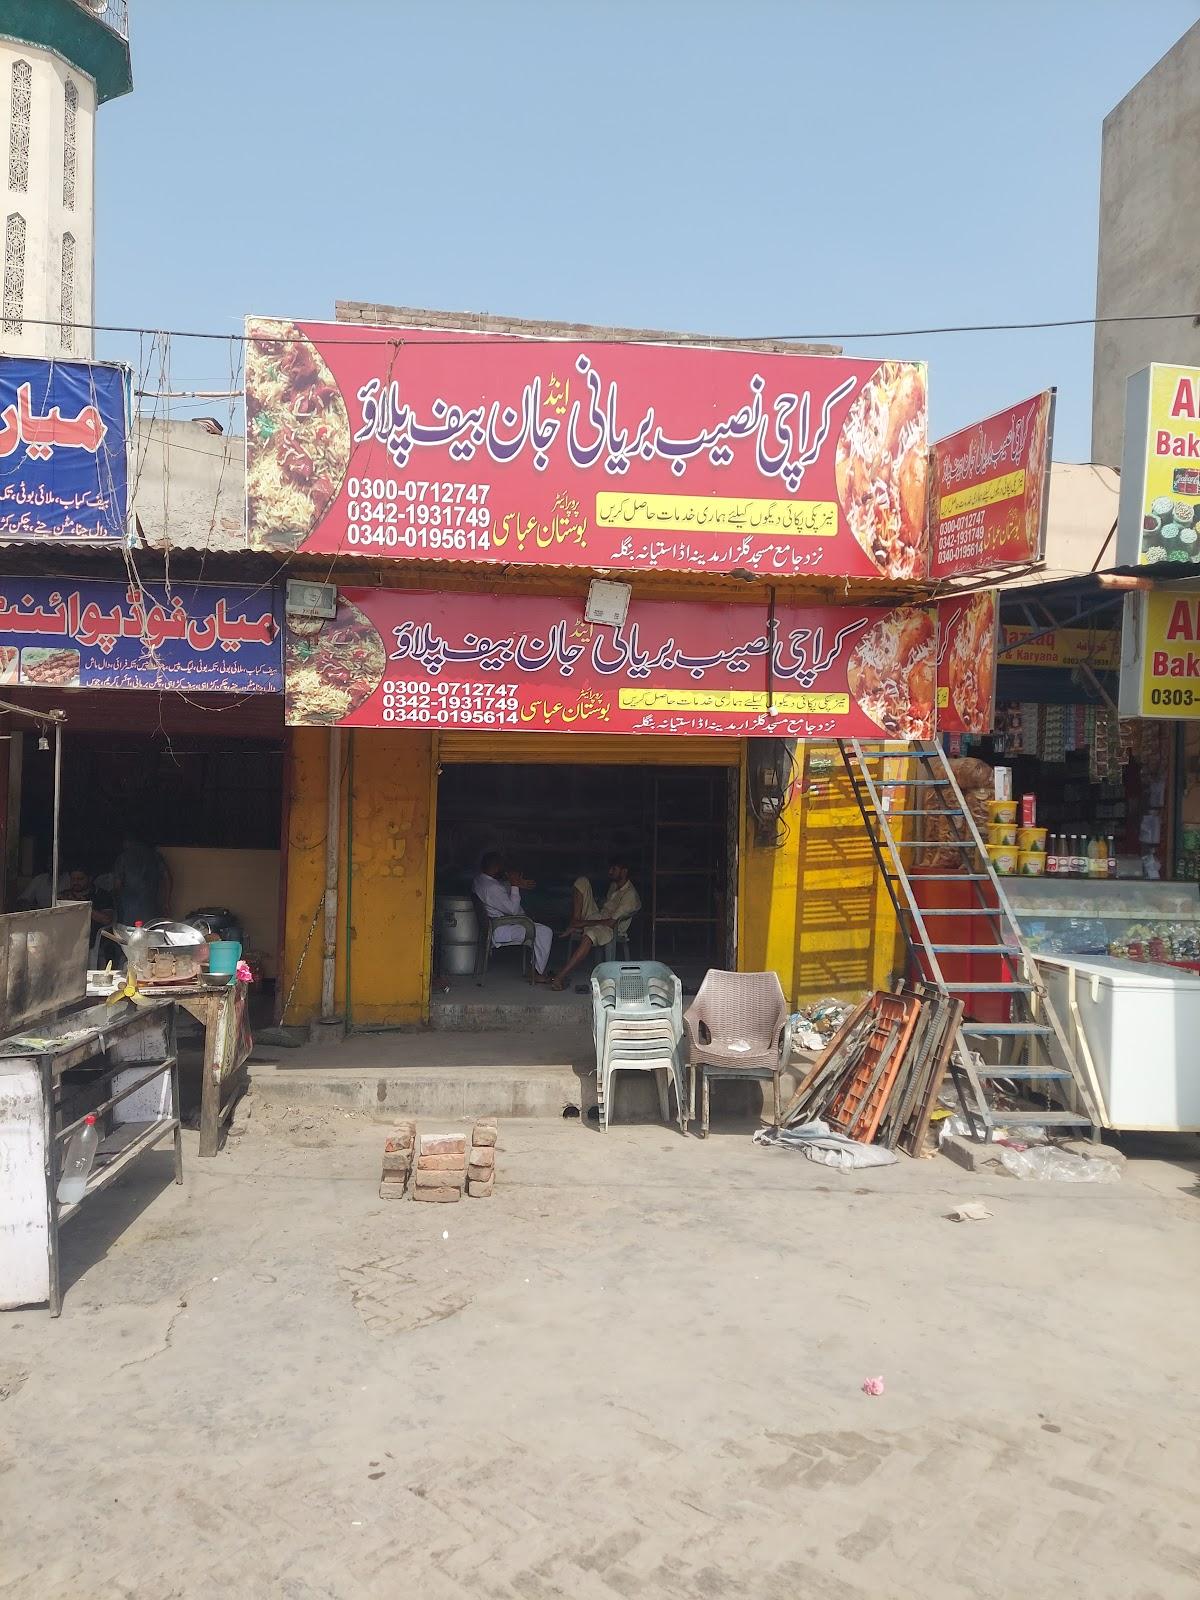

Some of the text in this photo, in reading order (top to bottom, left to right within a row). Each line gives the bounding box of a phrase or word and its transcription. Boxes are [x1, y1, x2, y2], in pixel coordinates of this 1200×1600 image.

[1172, 379, 1200, 418] A
[354, 353, 858, 493] کراچی نصیب بریانی اینڈ جان بیف پلاؤ
[34, 484, 55, 505] ملائی
[86, 493, 110, 509] بیف
[348, 478, 490, 504] 0300-0712747
[347, 501, 490, 527] 0342-1931749
[599, 498, 628, 522] کریں
[624, 500, 655, 521] حاصل
[656, 506, 694, 521] خدمات
[697, 507, 726, 525] ہماری
[750, 502, 781, 526] دیگوں
[805, 503, 822, 533] پکی
[819, 509, 834, 530] نیز
[9, 512, 31, 533] چکن
[89, 521, 107, 536] دال
[492, 512, 588, 550] بوستان عباسی
[940, 511, 985, 536] 0300-0712747
[347, 524, 490, 550] 0340-0195614
[610, 535, 636, 562] بنگلہ
[722, 535, 753, 563] گلزار
[939, 525, 985, 550] 0342-1931749
[690, 547, 722, 566] مدینہ
[747, 542, 774, 568] مسجد
[772, 544, 802, 570] جامع
[804, 545, 823, 565] نزد
[938, 541, 984, 564] 0340-0195614
[122, 584, 188, 649] فوڈ
[188, 600, 279, 652] میاں
[1167, 601, 1200, 640] A
[389, 622, 443, 676] پلاؤ
[442, 634, 515, 671] بیف
[515, 620, 585, 676] جان
[673, 619, 779, 678] نصیب
[772, 618, 868, 687] کراچی
[1016, 650, 1058, 662] Karyana
[383, 681, 518, 696] 0300-0712747
[622, 692, 652, 707] کریں
[650, 693, 677, 706] حاصل
[383, 695, 518, 710] 0342-1931749
[520, 699, 611, 724] بوستان عباسی
[718, 697, 743, 708] ہماری
[382, 709, 518, 724] 0340-0195614
[707, 719, 738, 732] مدینہ
[738, 714, 766, 731] گلزار
[763, 717, 789, 733] مسجد
[787, 719, 815, 734] جامع
[816, 719, 835, 732] نزد
